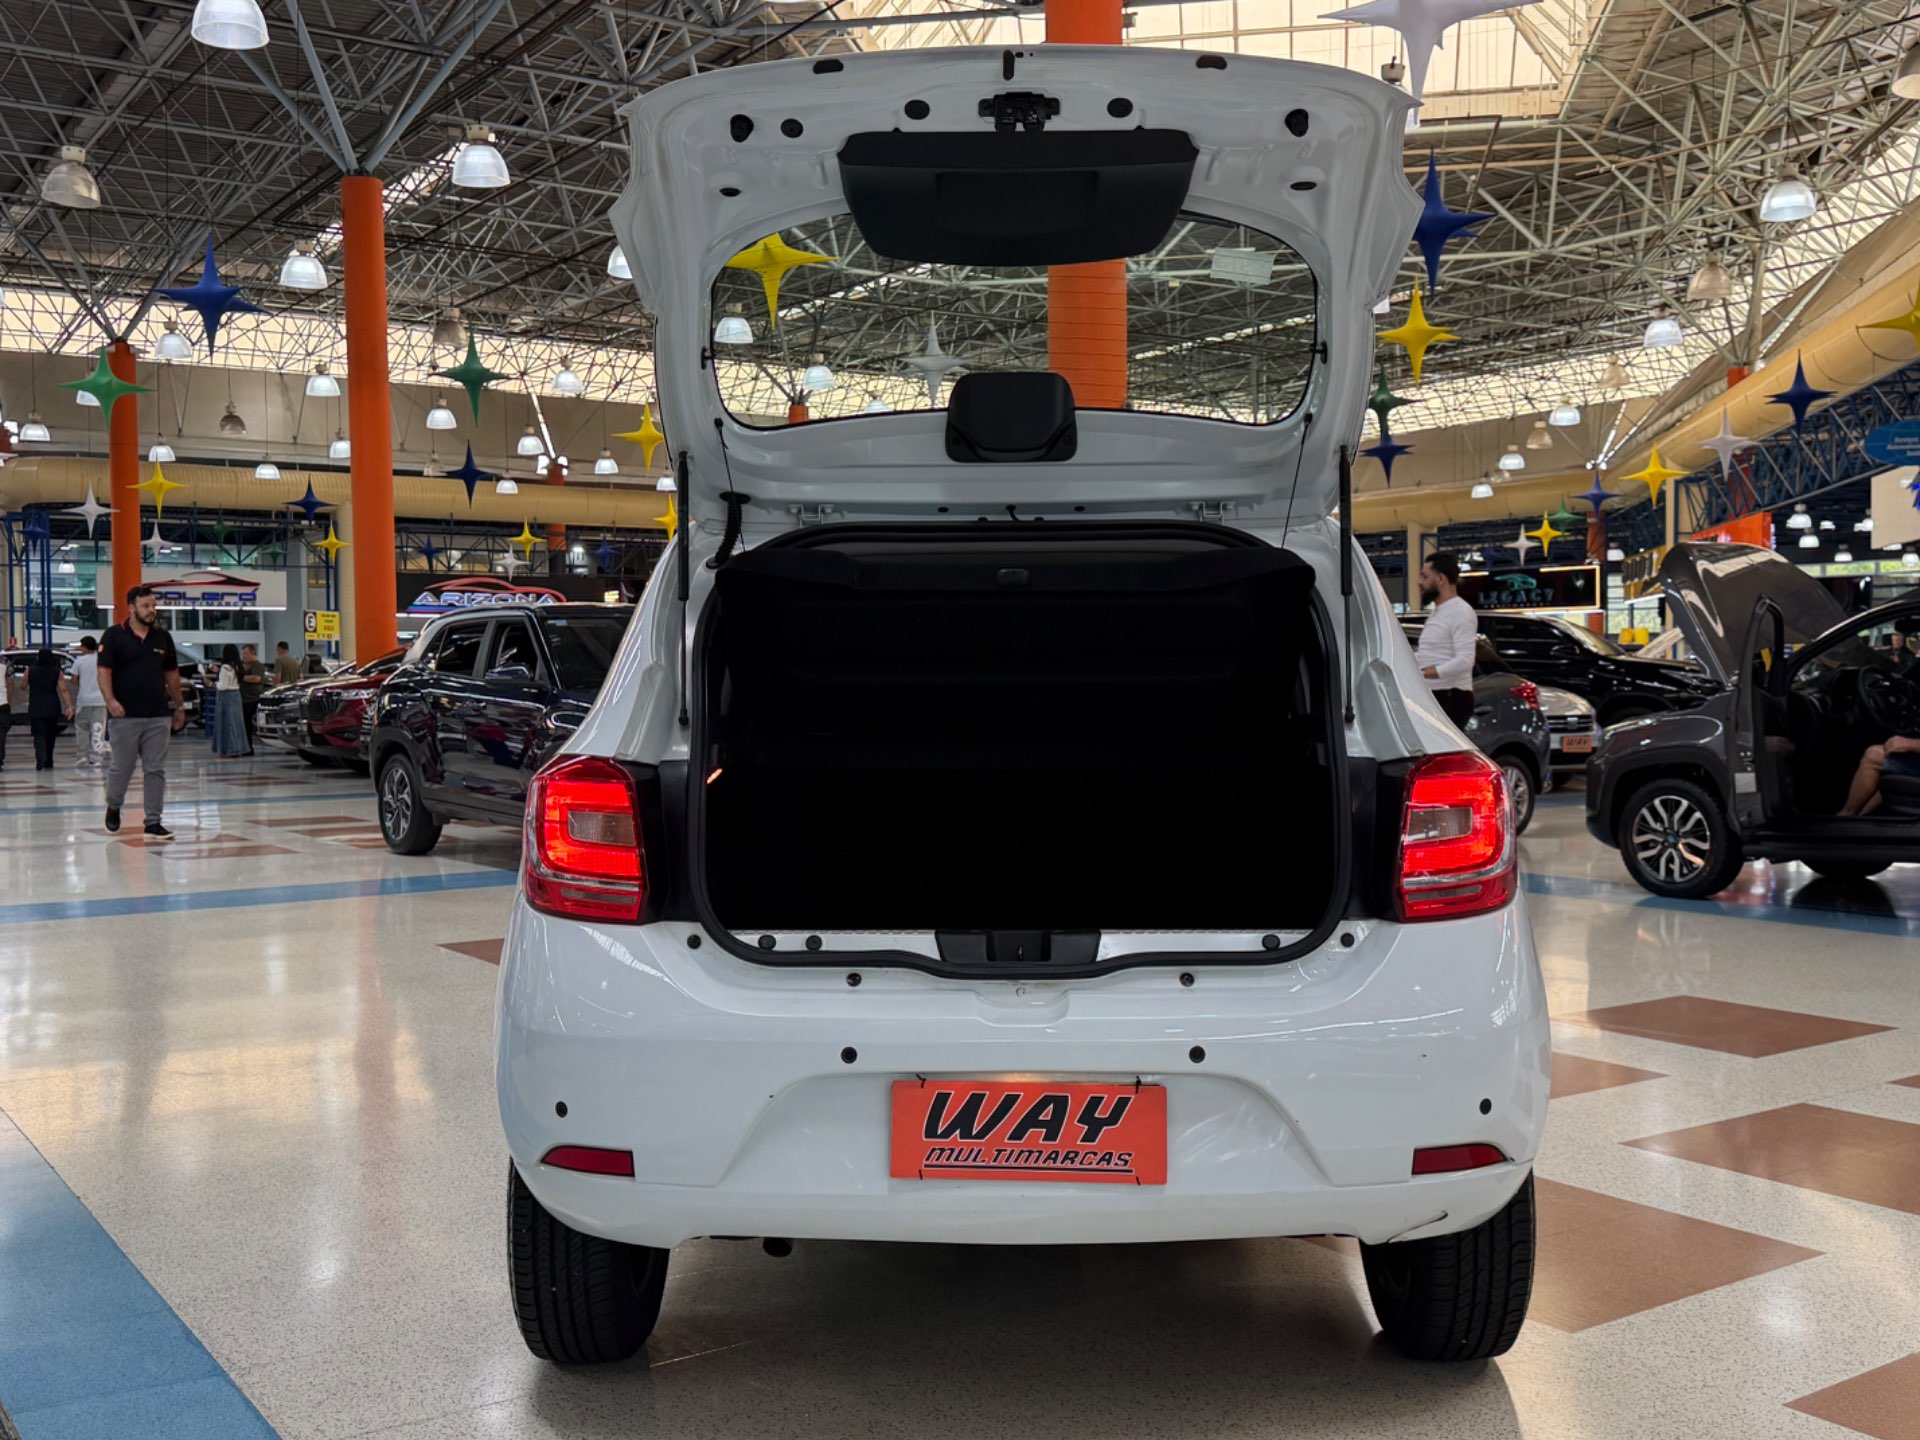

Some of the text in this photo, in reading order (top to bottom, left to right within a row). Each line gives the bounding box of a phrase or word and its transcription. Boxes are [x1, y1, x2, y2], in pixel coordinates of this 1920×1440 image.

[413, 591, 558, 606] ARIZONA
[1478, 588, 1554, 605] LEGACY
[922, 1091, 1134, 1145] WAY
[924, 1147, 1134, 1168] MULTIMARCAS
